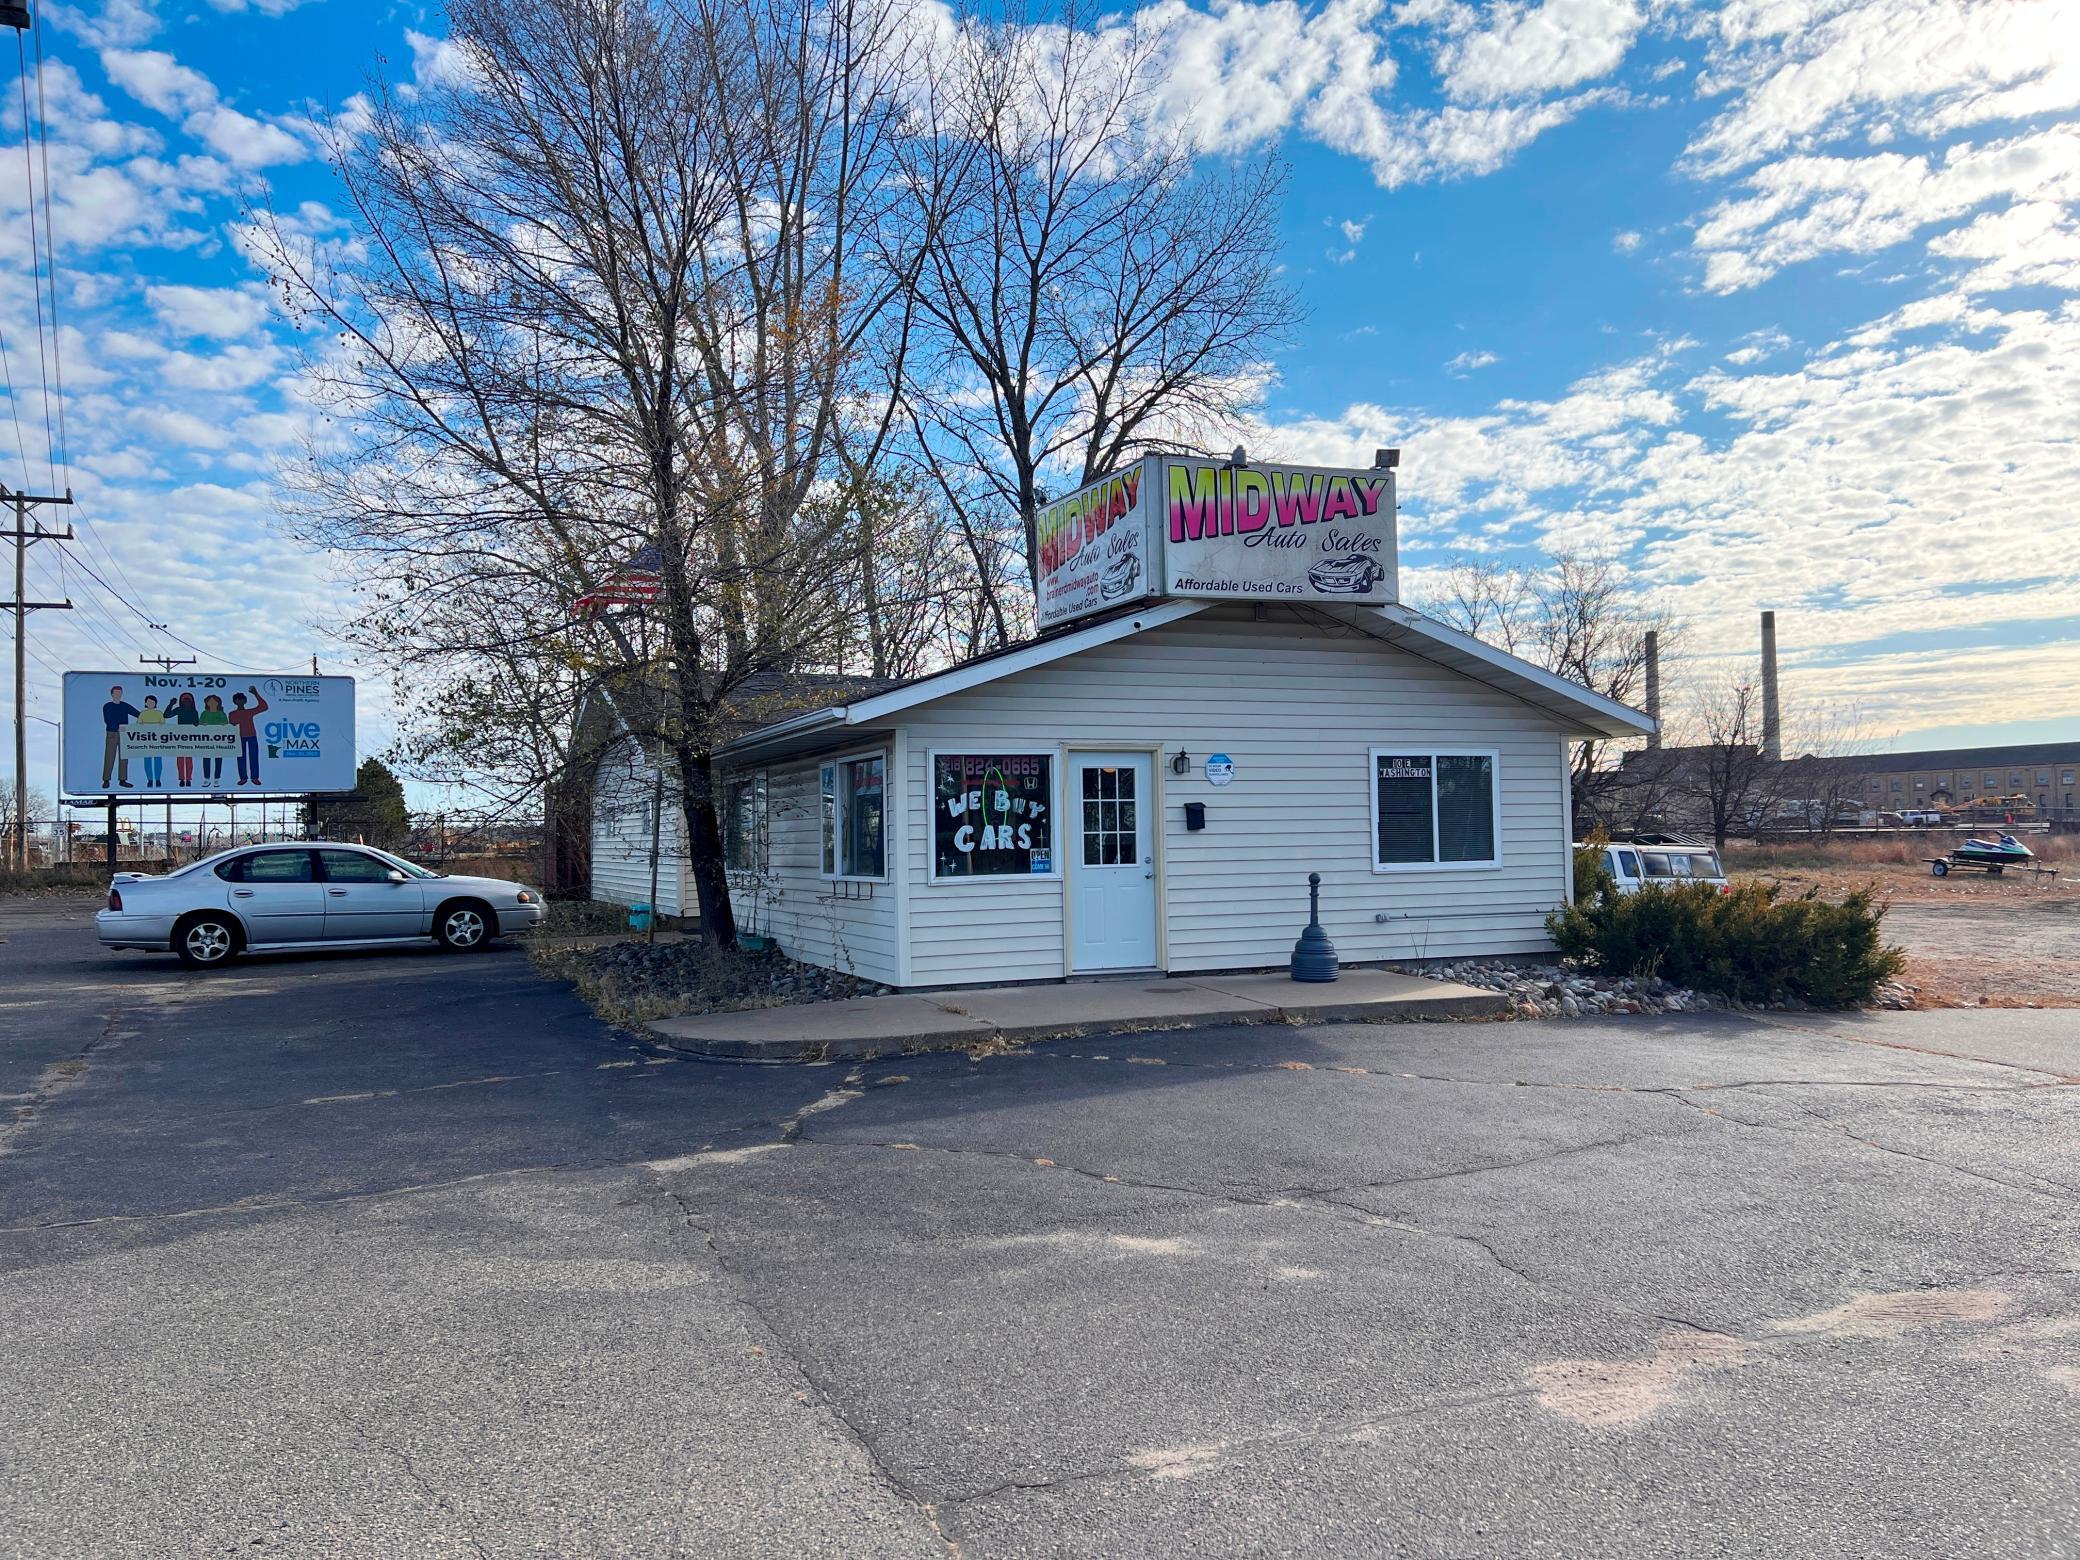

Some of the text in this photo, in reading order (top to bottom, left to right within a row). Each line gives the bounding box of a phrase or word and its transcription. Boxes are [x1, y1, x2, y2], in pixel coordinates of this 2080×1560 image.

[1168, 465, 1389, 543] MIDWAY
[1038, 465, 1142, 582] MIDWAY
[1244, 527, 1381, 552] Auto Sales
[1070, 530, 1139, 571] Auto Sales
[1046, 571, 1099, 600] brainerdmidwayauto
[1086, 584, 1099, 597] .com
[1175, 579, 1303, 594] Affordable Used Cars
[1069, 600, 1083, 614] Used
[1084, 597, 1098, 609] Cars
[145, 675, 226, 688] Nov. 1-20
[285, 685, 320, 694] PINES
[127, 731, 236, 744] Visit givemn.org
[264, 717, 321, 744] give
[286, 739, 320, 749] MAX
[966, 757, 1039, 775] 824-0665
[1379, 768, 1431, 777] WASHINGTON
[948, 790, 981, 817] WE
[954, 823, 1032, 852] CARS
[1031, 850, 1050, 860] OPEN
